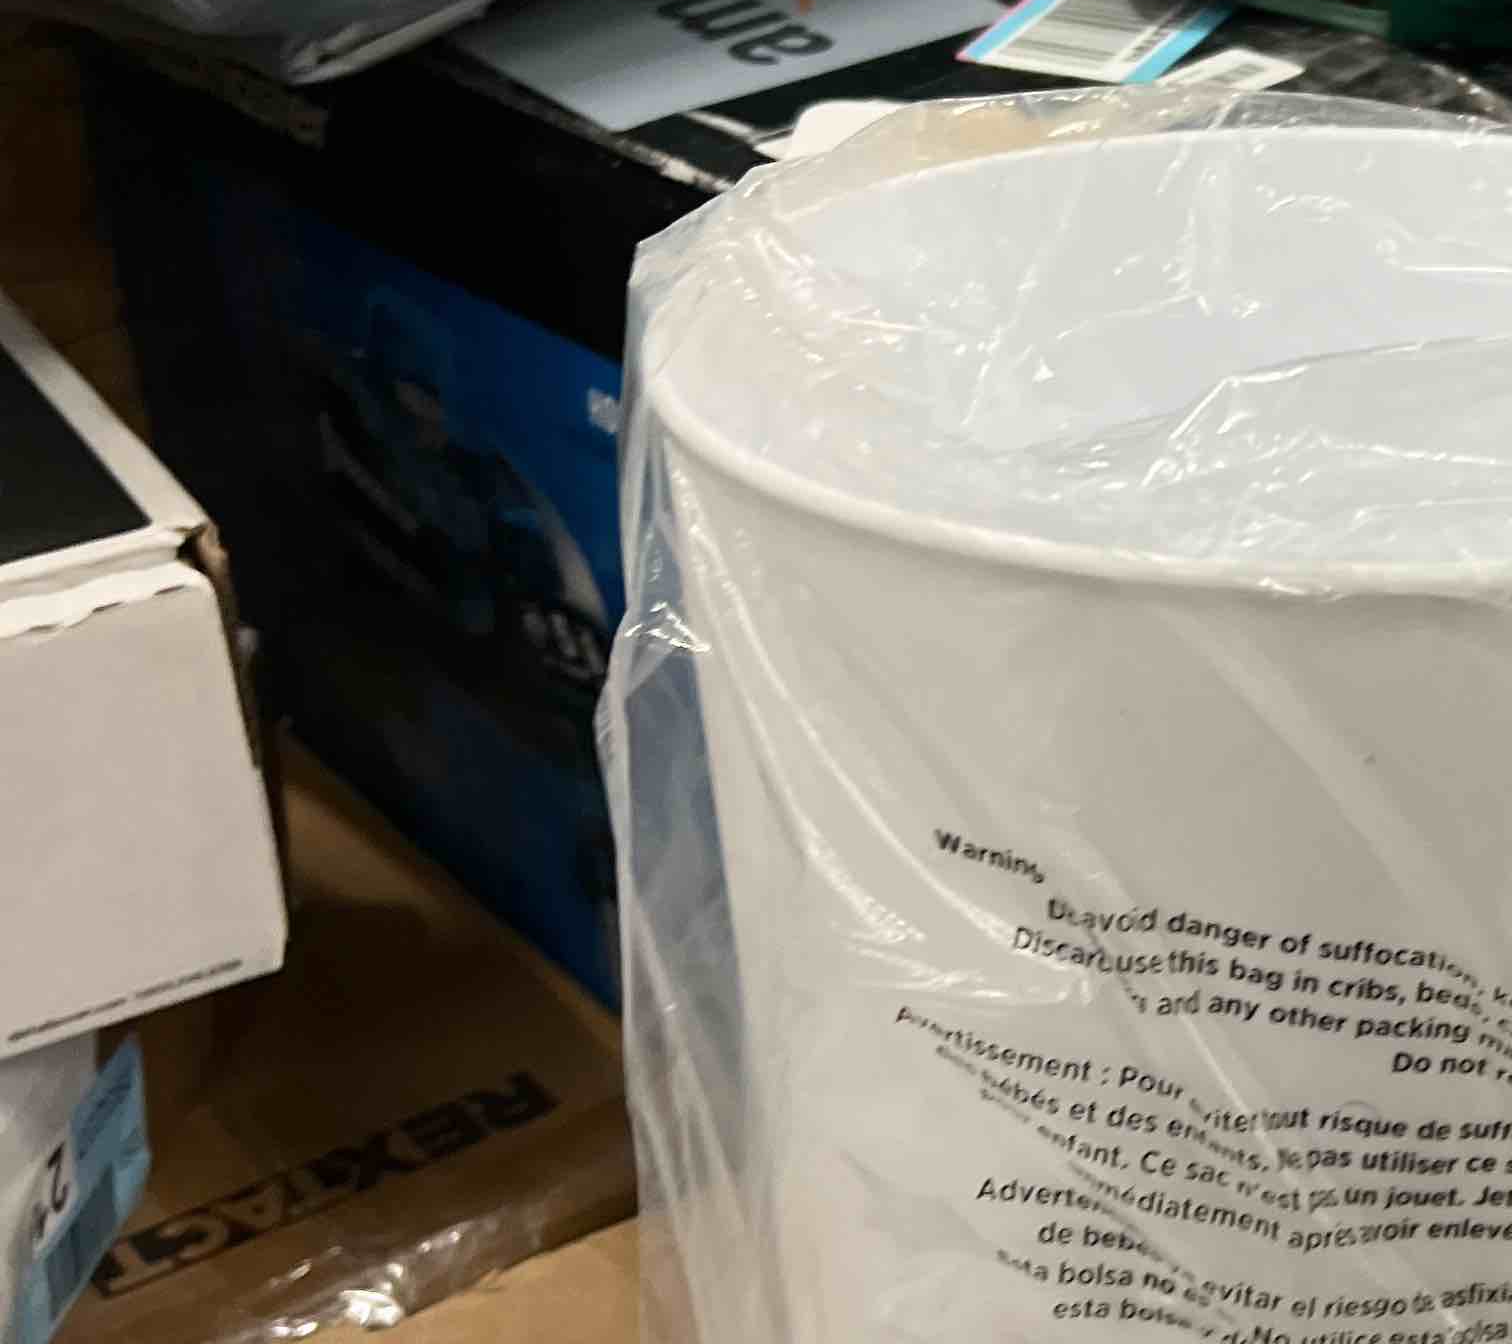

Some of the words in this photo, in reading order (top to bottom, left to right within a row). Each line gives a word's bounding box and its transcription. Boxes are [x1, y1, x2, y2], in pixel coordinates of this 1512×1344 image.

[1167, 909, 1272, 950] danger
[1279, 932, 1313, 956] of
[1168, 949, 1220, 976] this
[1229, 957, 1285, 992] bag
[1291, 969, 1320, 994] in
[1327, 976, 1407, 1007] cribs,
[1207, 994, 1261, 1022] any
[1268, 1005, 1348, 1034] other
[1354, 1016, 1472, 1045] packing
[1391, 1051, 1432, 1074] Do
[1439, 1055, 1489, 1076] not
[1118, 1064, 1185, 1101] Pour
[1318, 1108, 1409, 1138] risque
[1416, 1119, 1453, 1141] de
[1069, 1100, 1098, 1124] et
[1105, 1104, 1160, 1134] des
[1360, 1151, 1460, 1175] utiliser
[1465, 1155, 1498, 1174] ce
[1139, 1149, 1178, 1177] Ce
[1184, 1159, 1231, 1188] sac
[1343, 1186, 1379, 1206] un
[1383, 1184, 1466, 1212] jouet.
[1037, 1221, 1075, 1246] de
[1057, 1260, 1134, 1287] bolsa
[1142, 1270, 1176, 1295] no
[1201, 1279, 1285, 1312] evitar
[1290, 1295, 1318, 1319] el
[1322, 1297, 1408, 1319] riesgo
[1052, 1298, 1111, 1320] esta
[1118, 1297, 1193, 1330] bolsa
